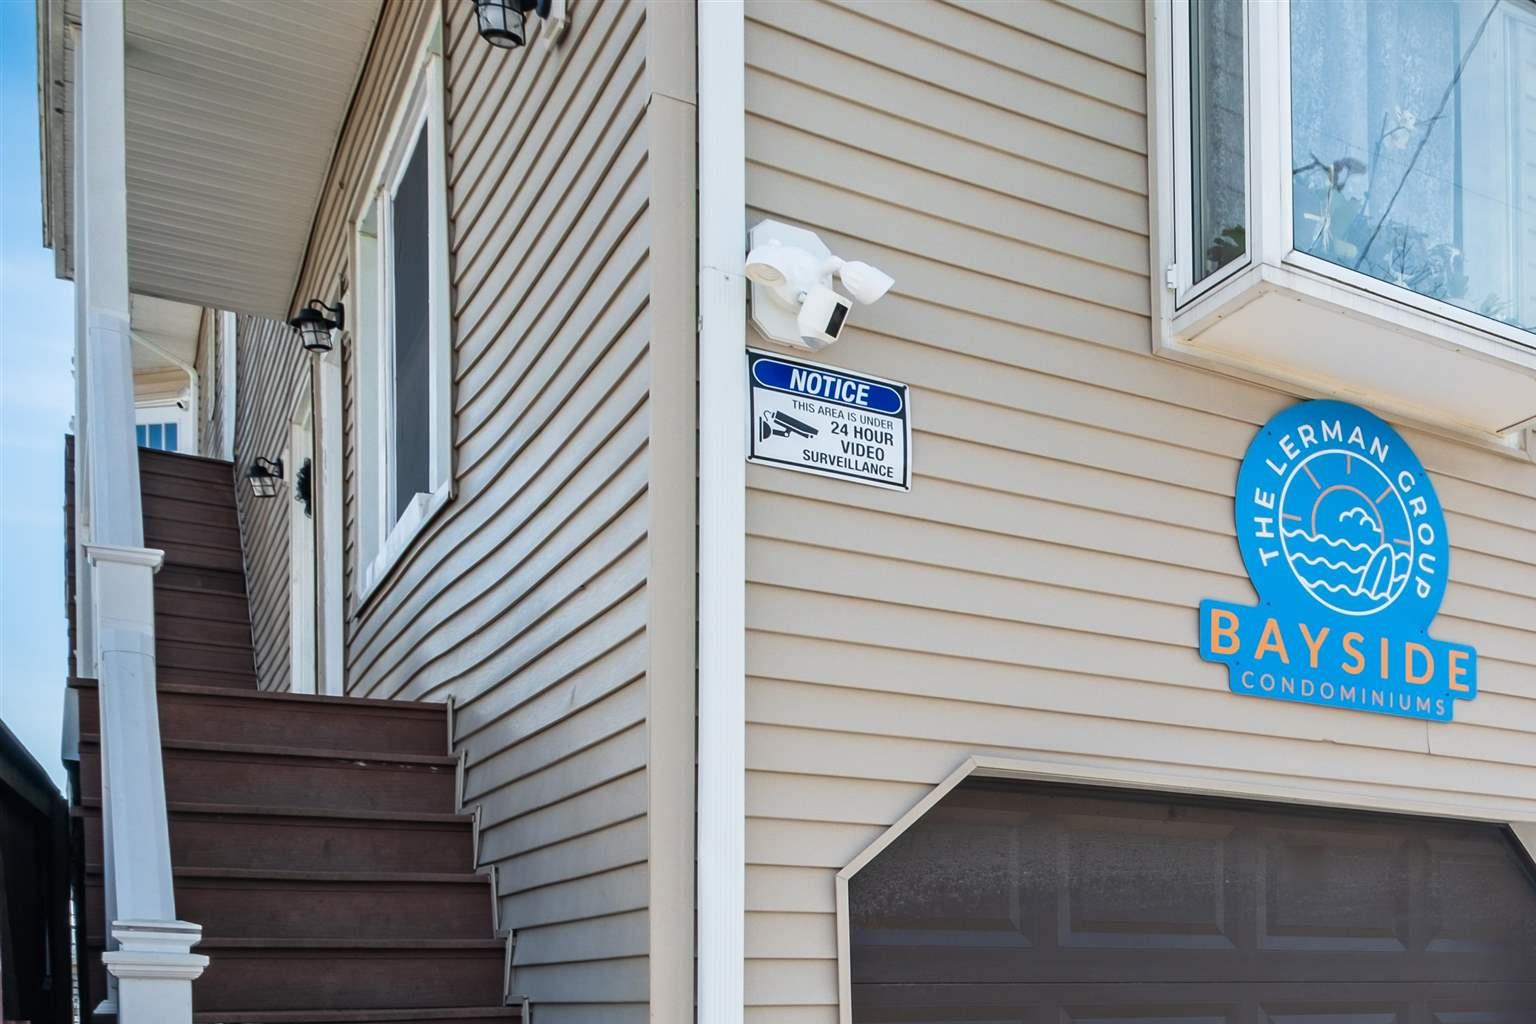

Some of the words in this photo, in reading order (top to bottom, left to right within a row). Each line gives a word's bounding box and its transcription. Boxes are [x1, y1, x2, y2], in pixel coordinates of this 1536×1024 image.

[790, 368, 870, 406] NOTICE
[792, 399, 815, 413] THIS
[818, 405, 845, 419] AREA
[847, 412, 857, 422] IS
[859, 414, 894, 430] UNDER
[831, 421, 849, 436] 24
[854, 425, 894, 446] HOUR
[802, 449, 894, 478] SURVEILLANCE
[841, 440, 885, 461] VIDEO
[1265, 420, 1389, 476] LERMAN
[1254, 487, 1279, 567] THE
[1398, 471, 1436, 598] GROUP
[1210, 608, 1470, 692] BAYSIDE
[1241, 671, 1446, 716] CONDOMINIUMS
